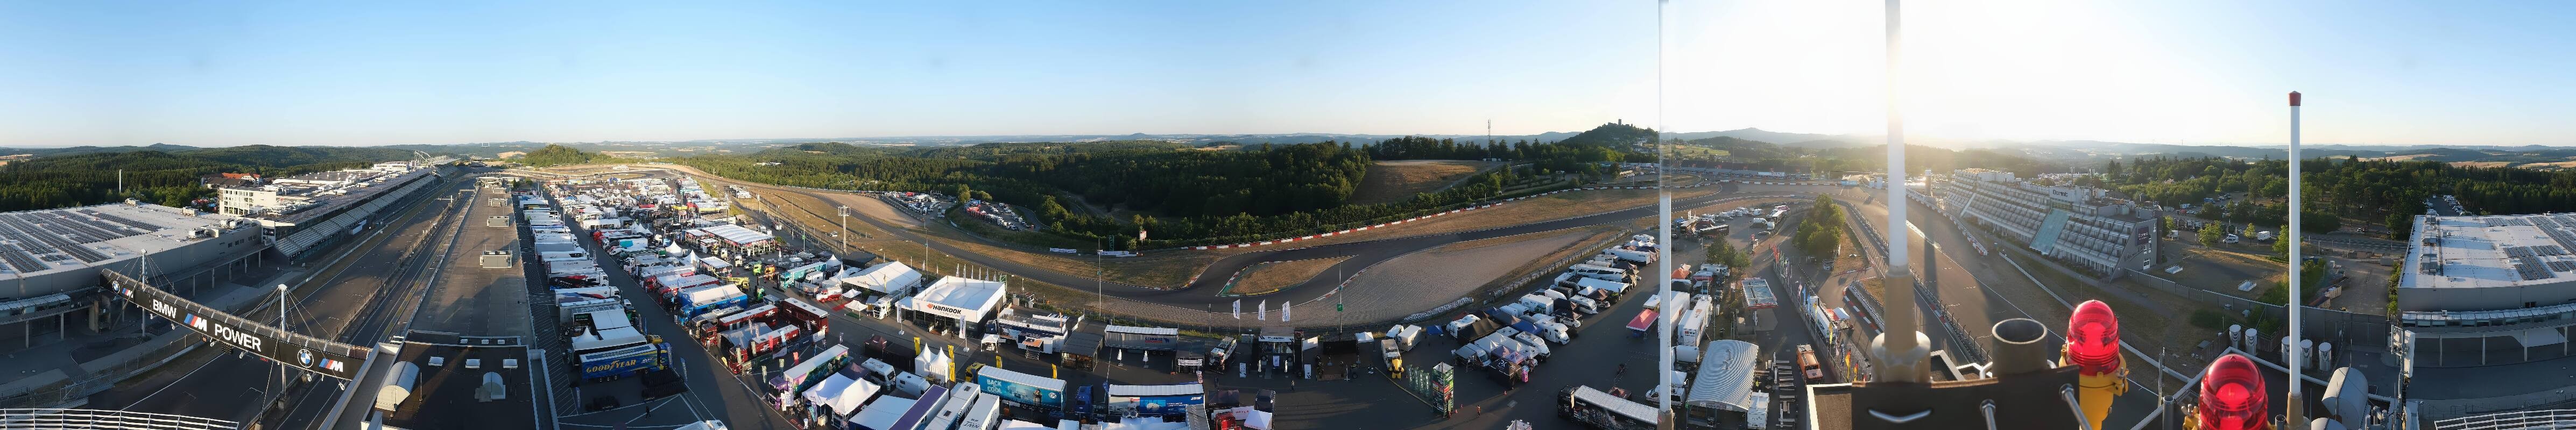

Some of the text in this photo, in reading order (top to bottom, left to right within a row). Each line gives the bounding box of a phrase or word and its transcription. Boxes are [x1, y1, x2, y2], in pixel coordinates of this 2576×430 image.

[153, 299, 177, 318] BMW
[215, 324, 261, 352] POWER
[586, 360, 637, 373] GOODYEAR
